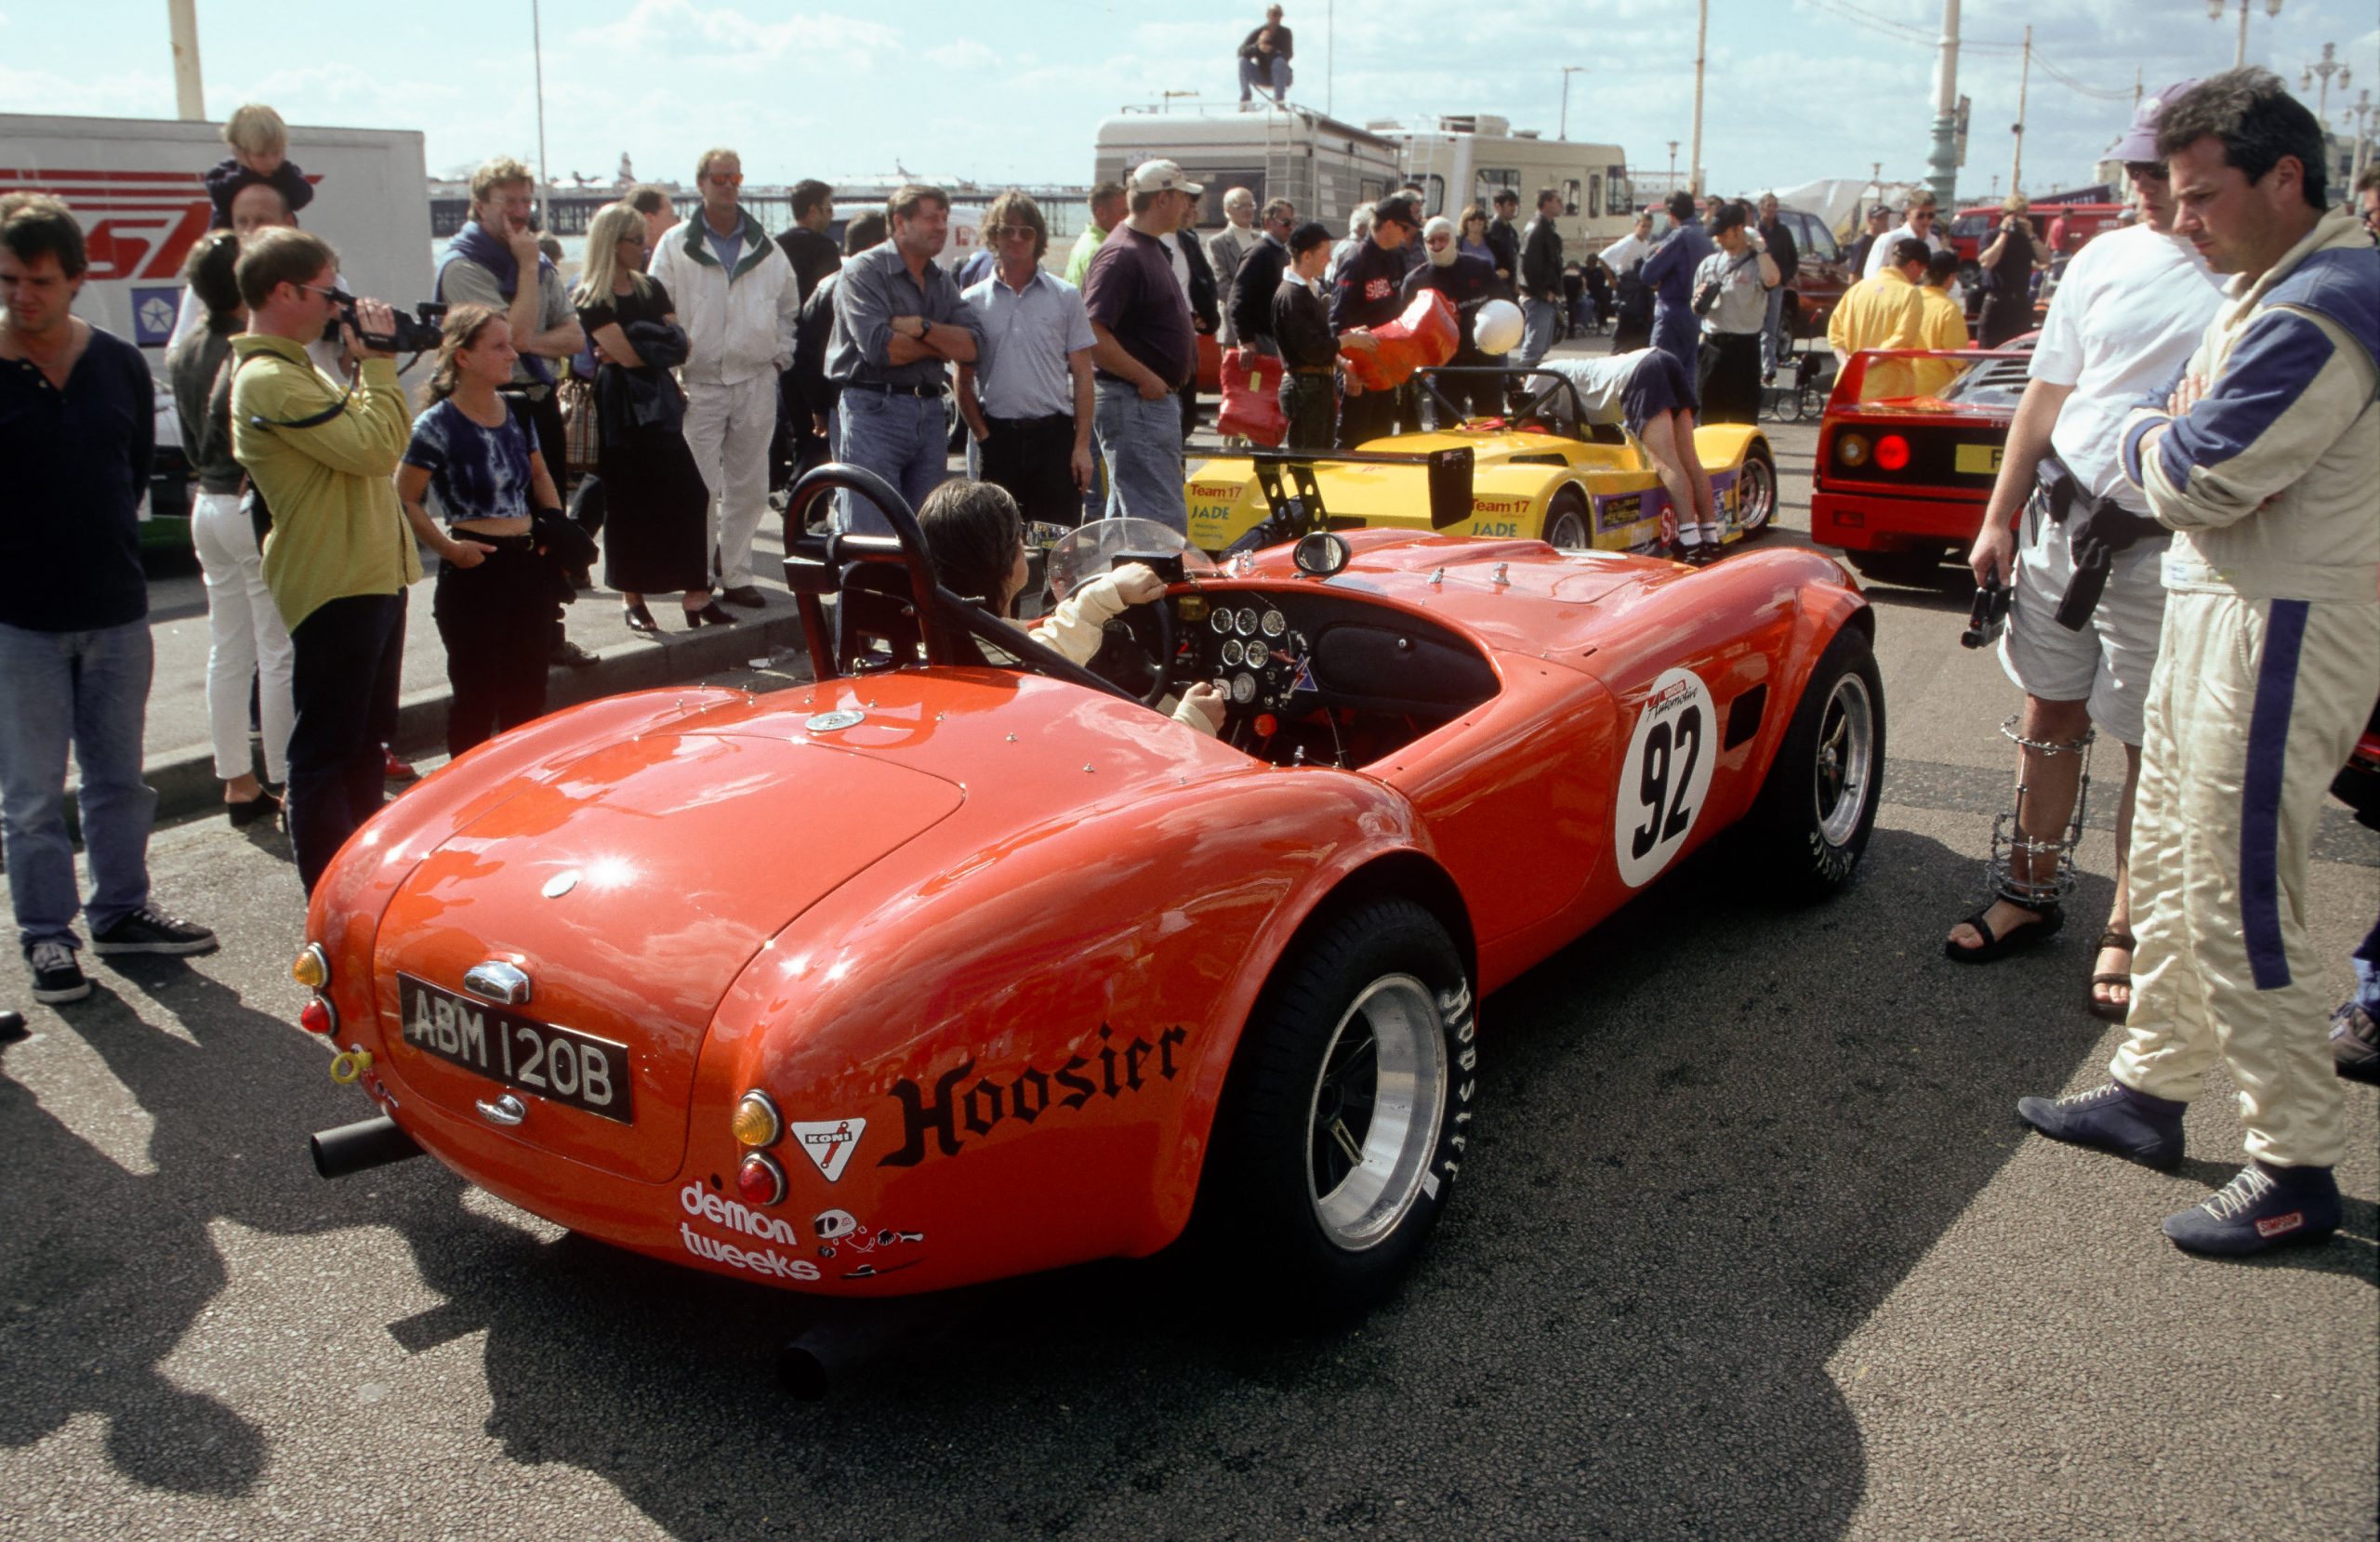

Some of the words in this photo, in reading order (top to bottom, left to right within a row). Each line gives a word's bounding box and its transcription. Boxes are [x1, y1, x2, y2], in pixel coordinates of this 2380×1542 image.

[1191, 483, 1225, 497] Team
[1229, 486, 1242, 498] 17
[1473, 498, 1511, 512] Team
[1514, 500, 1530, 513] 17
[1191, 505, 1230, 521] JADE
[1473, 521, 1517, 536] JADE
[1633, 705, 1701, 860] 92
[415, 990, 487, 1068] ABM
[501, 1021, 613, 1106] 120B
[877, 1021, 1187, 1167] Hoosier
[807, 1132, 851, 1143] KONI
[681, 1181, 797, 1245] demon
[680, 1222, 821, 1280] tweeks
